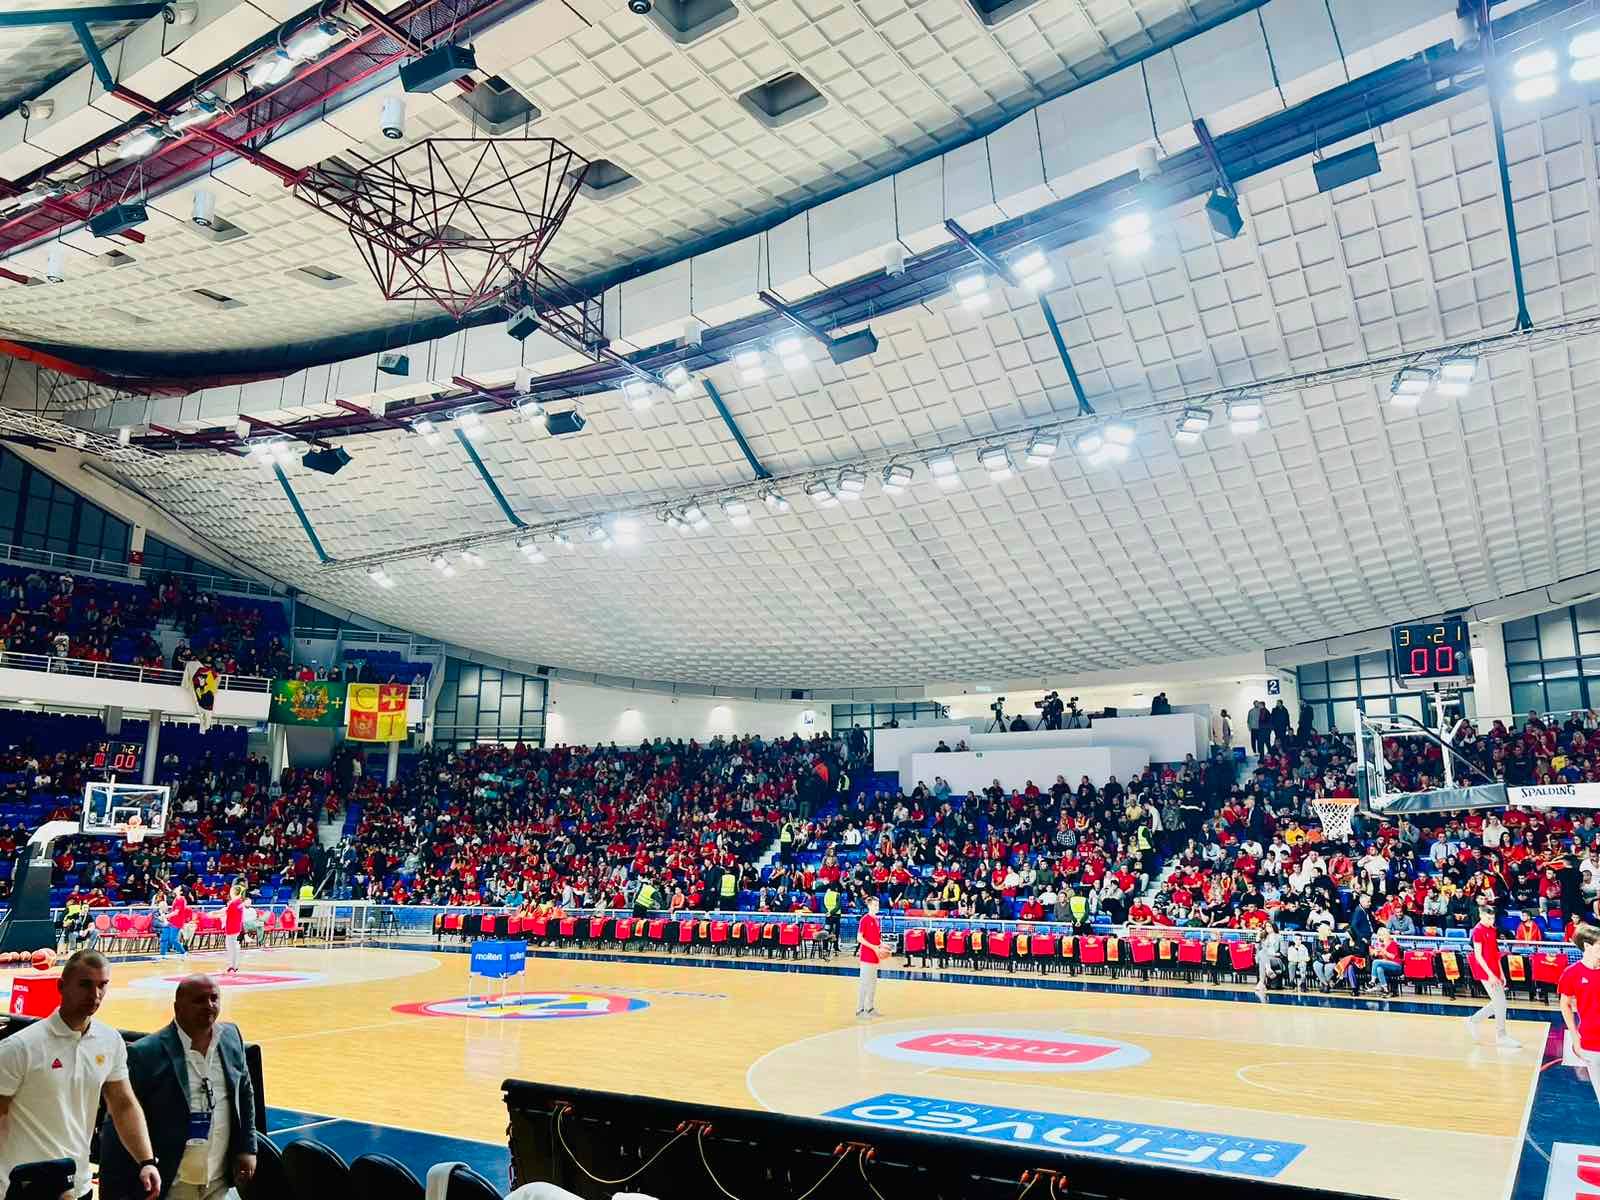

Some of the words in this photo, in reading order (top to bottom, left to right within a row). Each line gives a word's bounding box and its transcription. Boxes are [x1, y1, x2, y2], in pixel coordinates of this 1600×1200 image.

[1411, 646, 1453, 674] 00
[1269, 680, 1278, 691] 2
[114, 753, 137, 769] 00
[1520, 784, 1576, 798] SPALDING
[475, 953, 503, 961] molten
[889, 1097, 993, 1115] INVEO
[1005, 1112, 1045, 1121] of
[1064, 1119, 1281, 1153] Subsidiary
